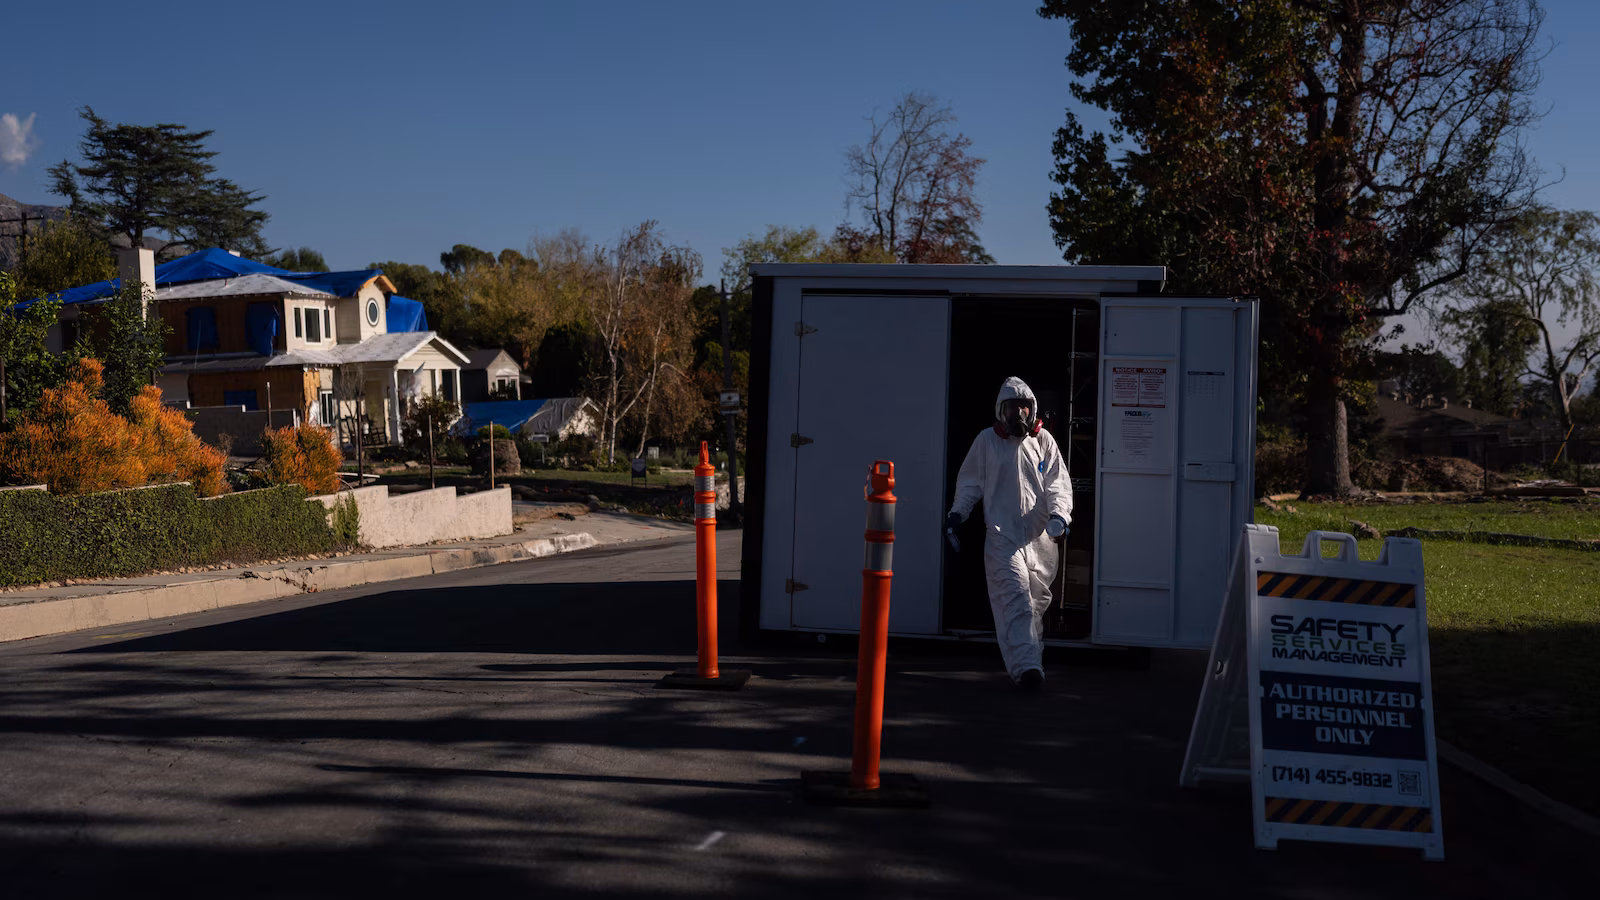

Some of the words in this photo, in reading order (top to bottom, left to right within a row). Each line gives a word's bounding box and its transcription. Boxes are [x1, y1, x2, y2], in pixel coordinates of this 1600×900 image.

[1270, 614, 1405, 643] SAFETY
[1271, 634, 1406, 657] SERVICES
[1272, 647, 1407, 668] MANAGEMENT
[1269, 682, 1416, 709] AUTHORIZED
[1275, 703, 1412, 729] PERSONNEL
[1315, 726, 1375, 746] ONLY
[1272, 765, 1310, 784] (714)
[1315, 768, 1393, 789] 455-9832
